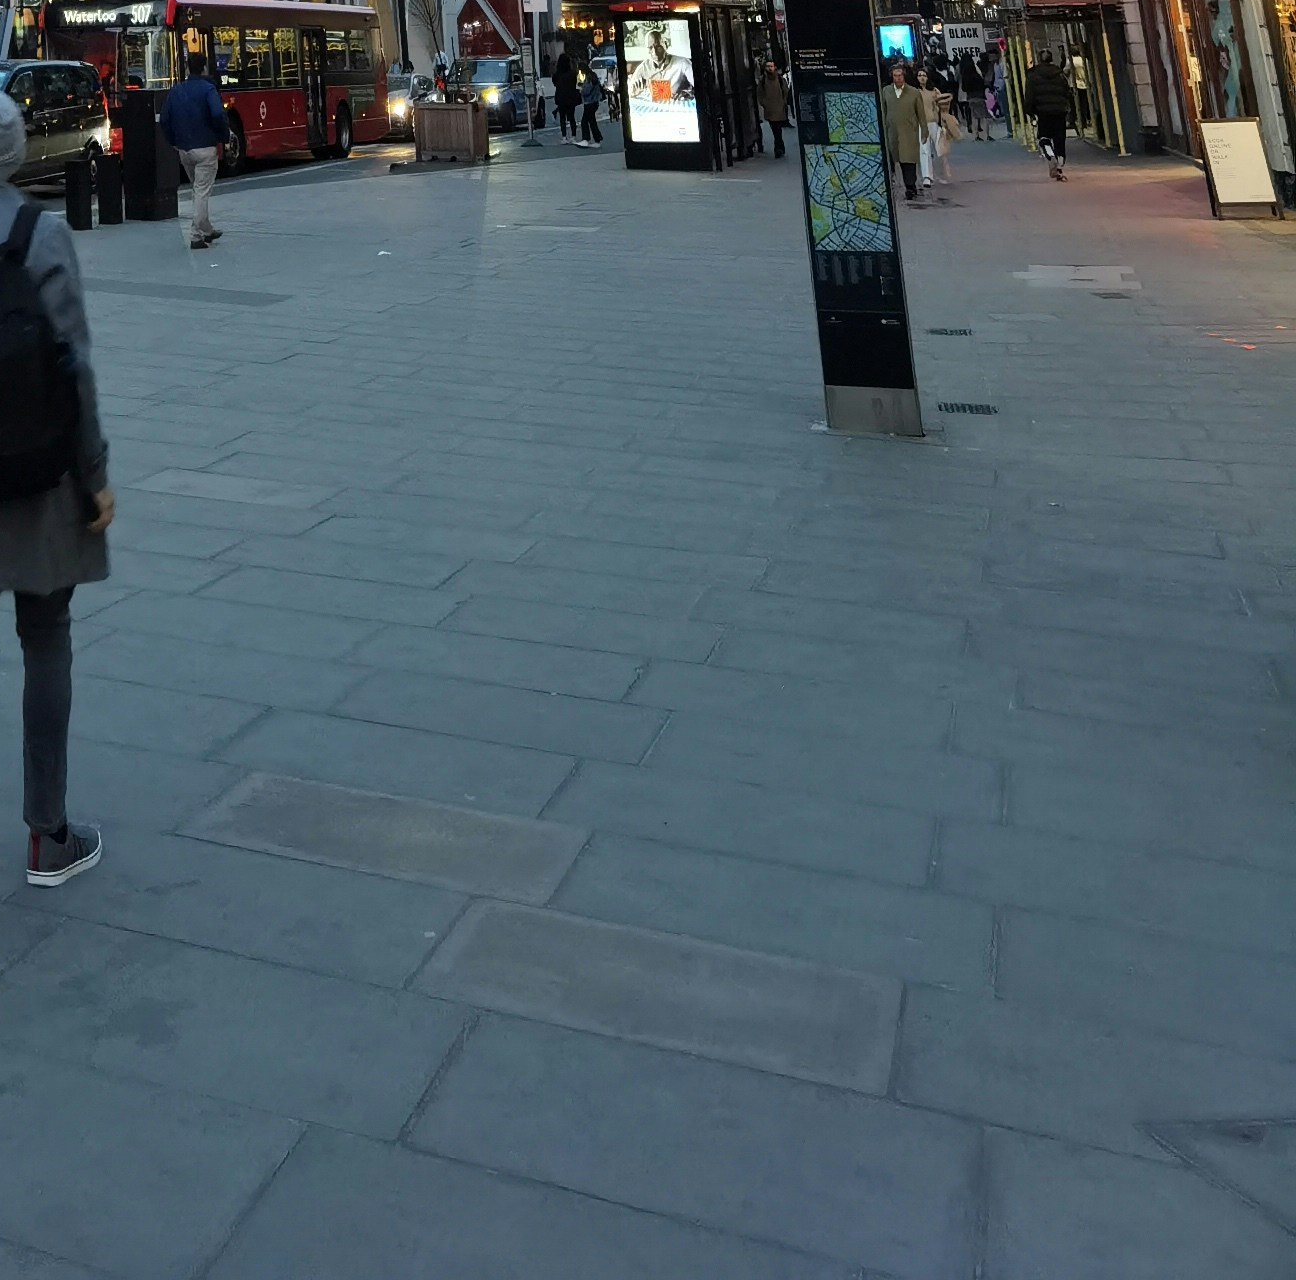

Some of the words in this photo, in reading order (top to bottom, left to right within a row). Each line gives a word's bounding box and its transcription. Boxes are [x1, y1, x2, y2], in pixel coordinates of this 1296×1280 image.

[64, 9, 117, 24] Waterloo
[130, 4, 153, 24] 507
[948, 27, 979, 39] BLACK
[951, 46, 981, 58] SHEEP
